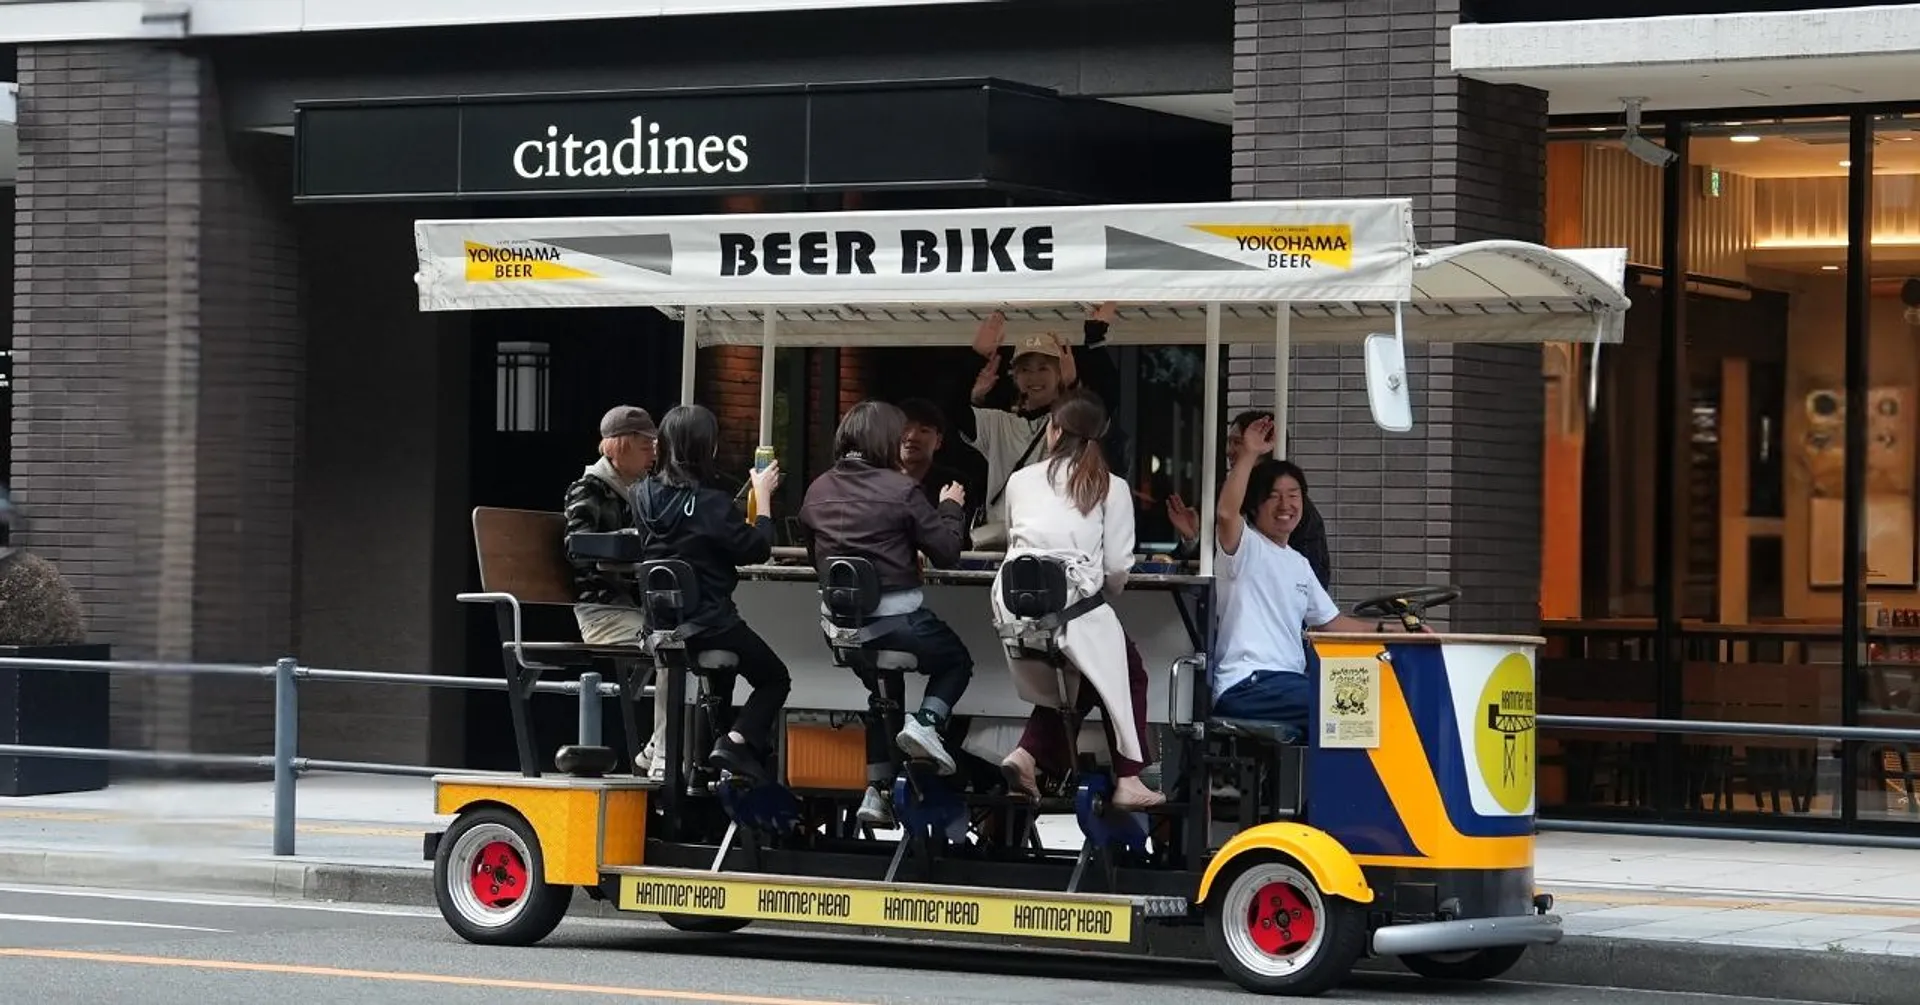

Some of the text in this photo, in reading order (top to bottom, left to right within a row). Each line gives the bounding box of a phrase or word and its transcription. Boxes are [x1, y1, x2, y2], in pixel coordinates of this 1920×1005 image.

[513, 116, 749, 178] citadines
[720, 226, 1054, 276] BEER BIKE
[1236, 236, 1346, 251] YOKOHAMA
[468, 248, 560, 262] YOKOHAMA
[1267, 253, 1311, 268] BEER
[495, 264, 532, 278] BEER
